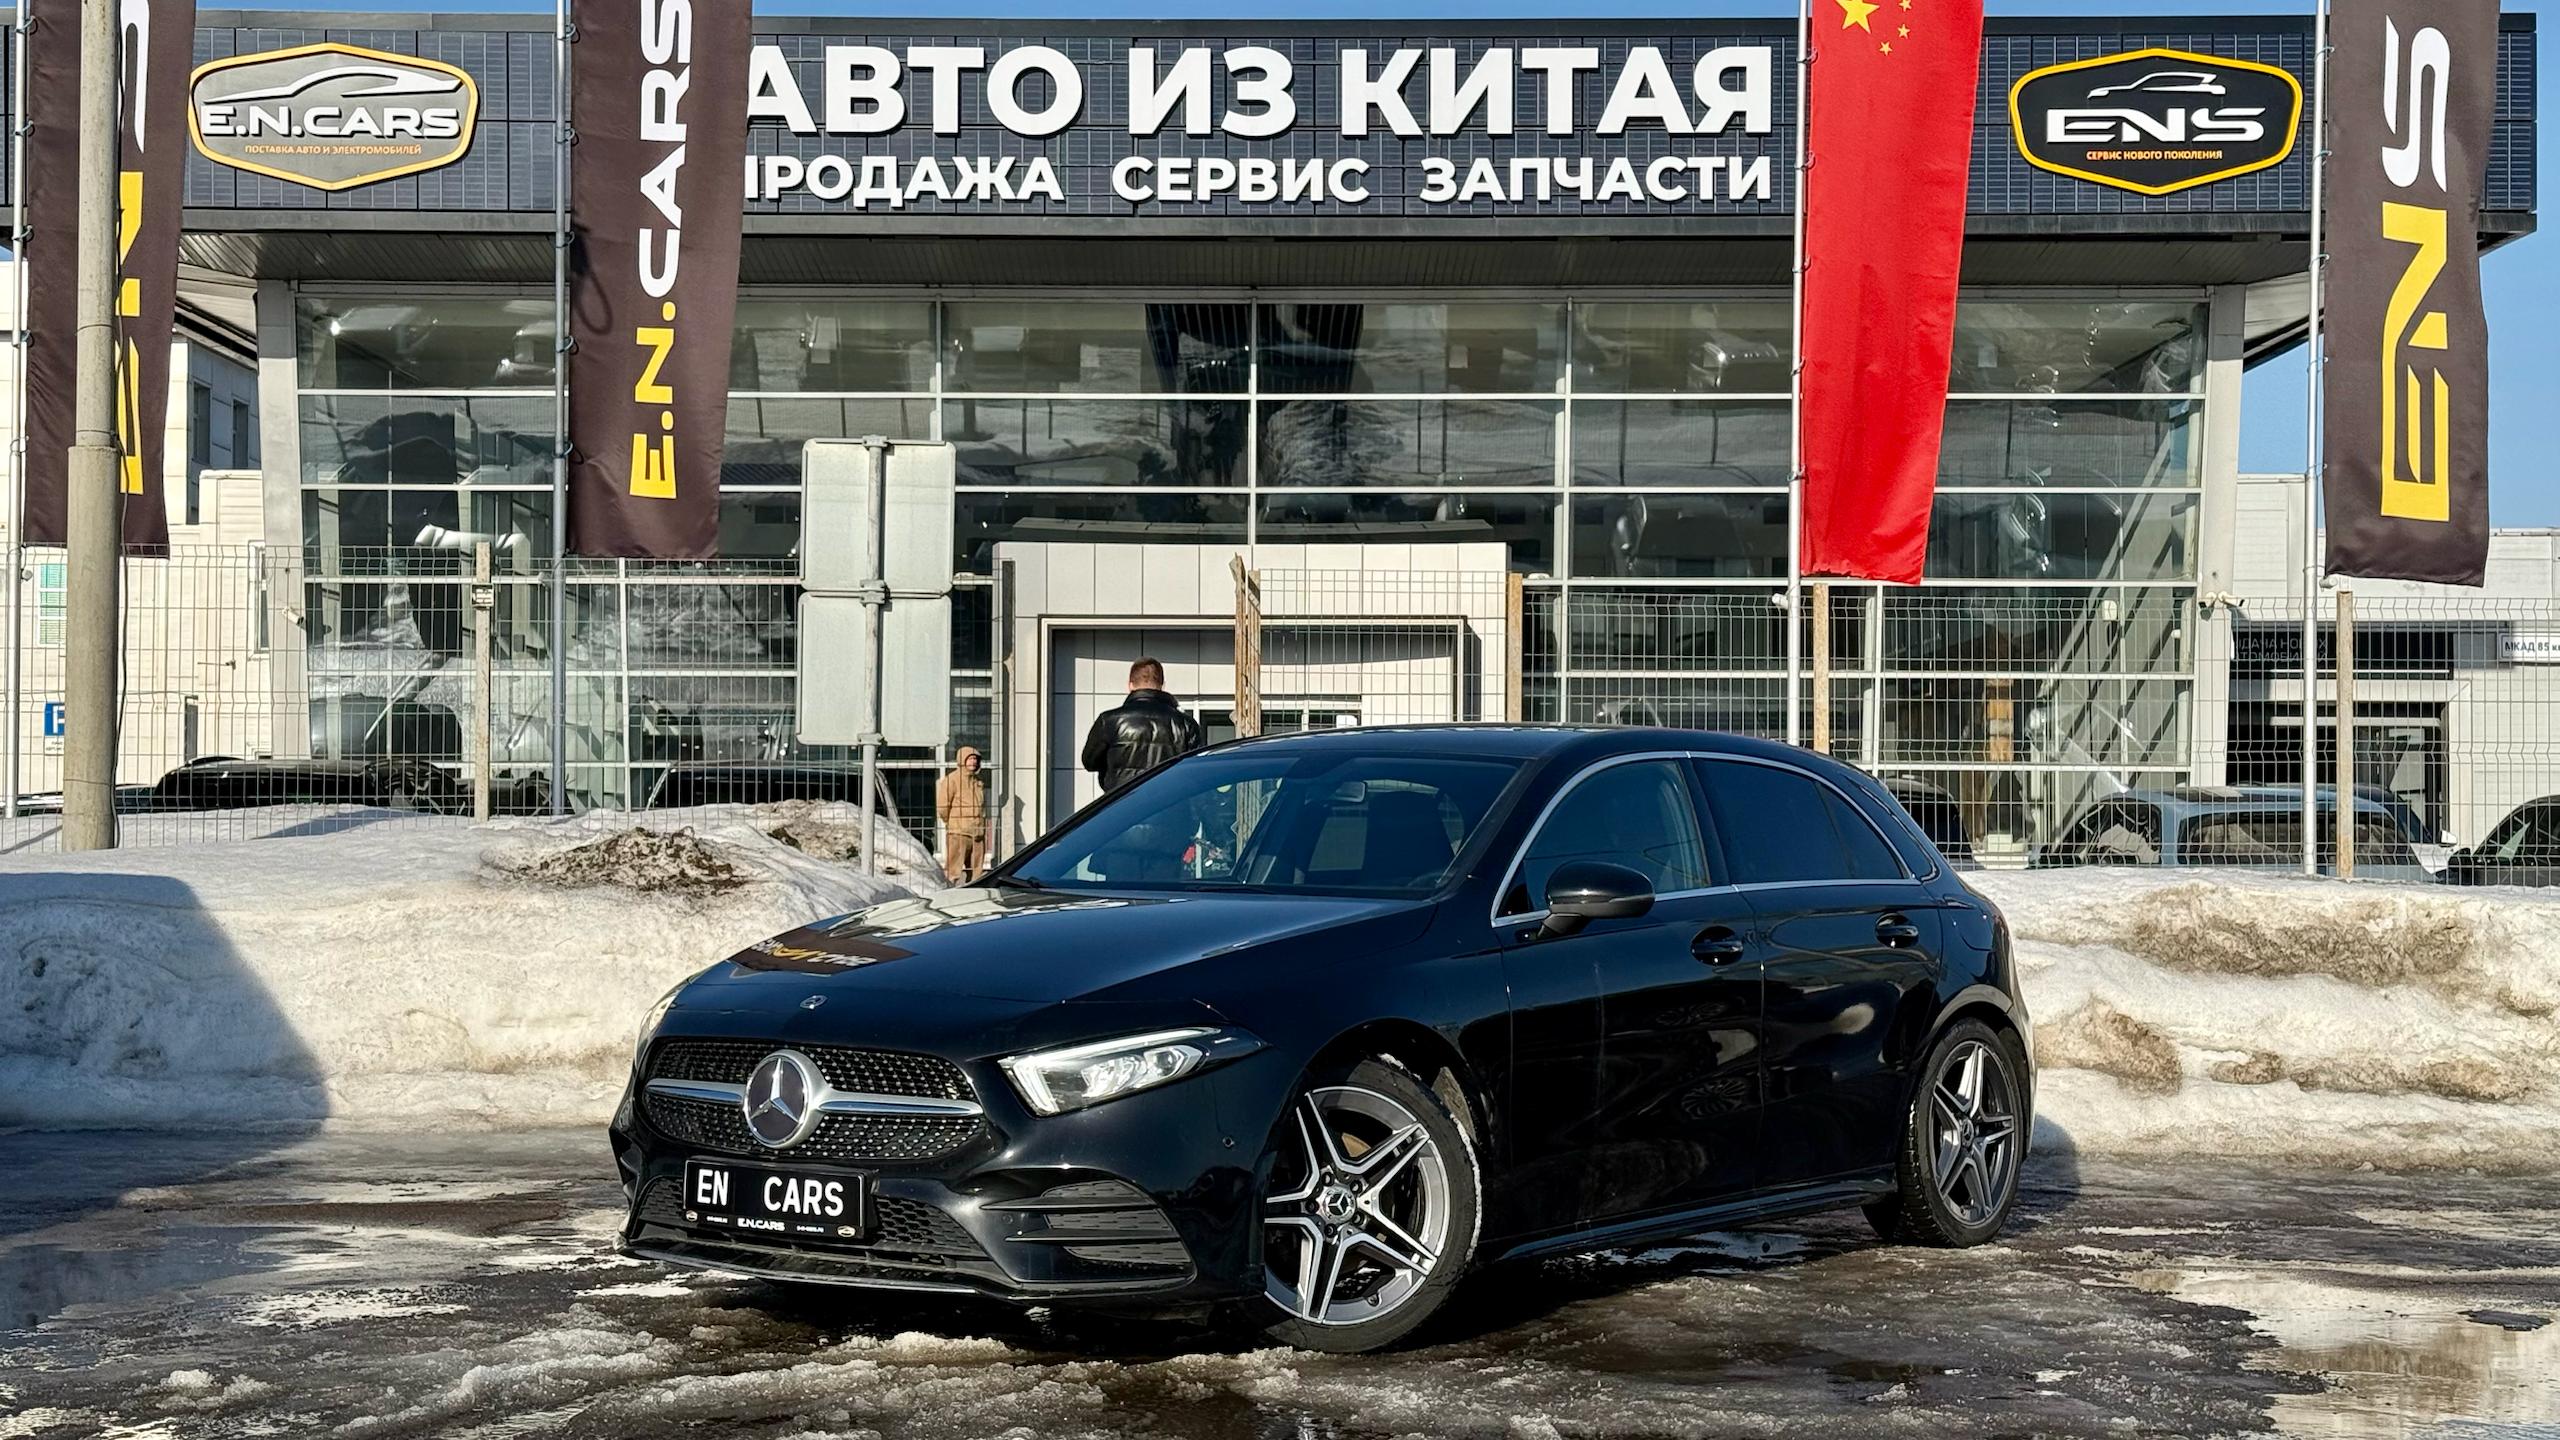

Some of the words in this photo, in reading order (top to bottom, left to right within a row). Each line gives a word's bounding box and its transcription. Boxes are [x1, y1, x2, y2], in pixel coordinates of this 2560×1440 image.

[747, 45, 1083, 136] АВТО
[1128, 46, 1297, 137] ИЗ
[1341, 46, 1772, 136] КИТАЯ
[201, 105, 461, 138] E.N.CARS
[2047, 107, 2266, 143] ENS
[245, 144, 294, 154] ПОСТАВКА
[296, 144, 321, 154] АВТО
[323, 145, 330, 154] И
[332, 143, 422, 155] ЭЛЕКТРОМОБИЛЕЙ
[2086, 151, 2121, 161] СЕРВИС
[2123, 151, 2162, 160] НОВОГО
[2164, 150, 2223, 160] ПОКОЛЕНИЯ
[1112, 156, 1370, 202] СЕРВИС
[1420, 156, 1771, 202] ЗАПЧАСТИ
[630, 0, 693, 498] E.N.CARS
[2380, 14, 2451, 522] ENS
[2505, 641, 2535, 652] МКАД
[2537, 641, 2550, 651] 85
[697, 1168, 729, 1206] EN
[764, 1176, 844, 1217] CARS
